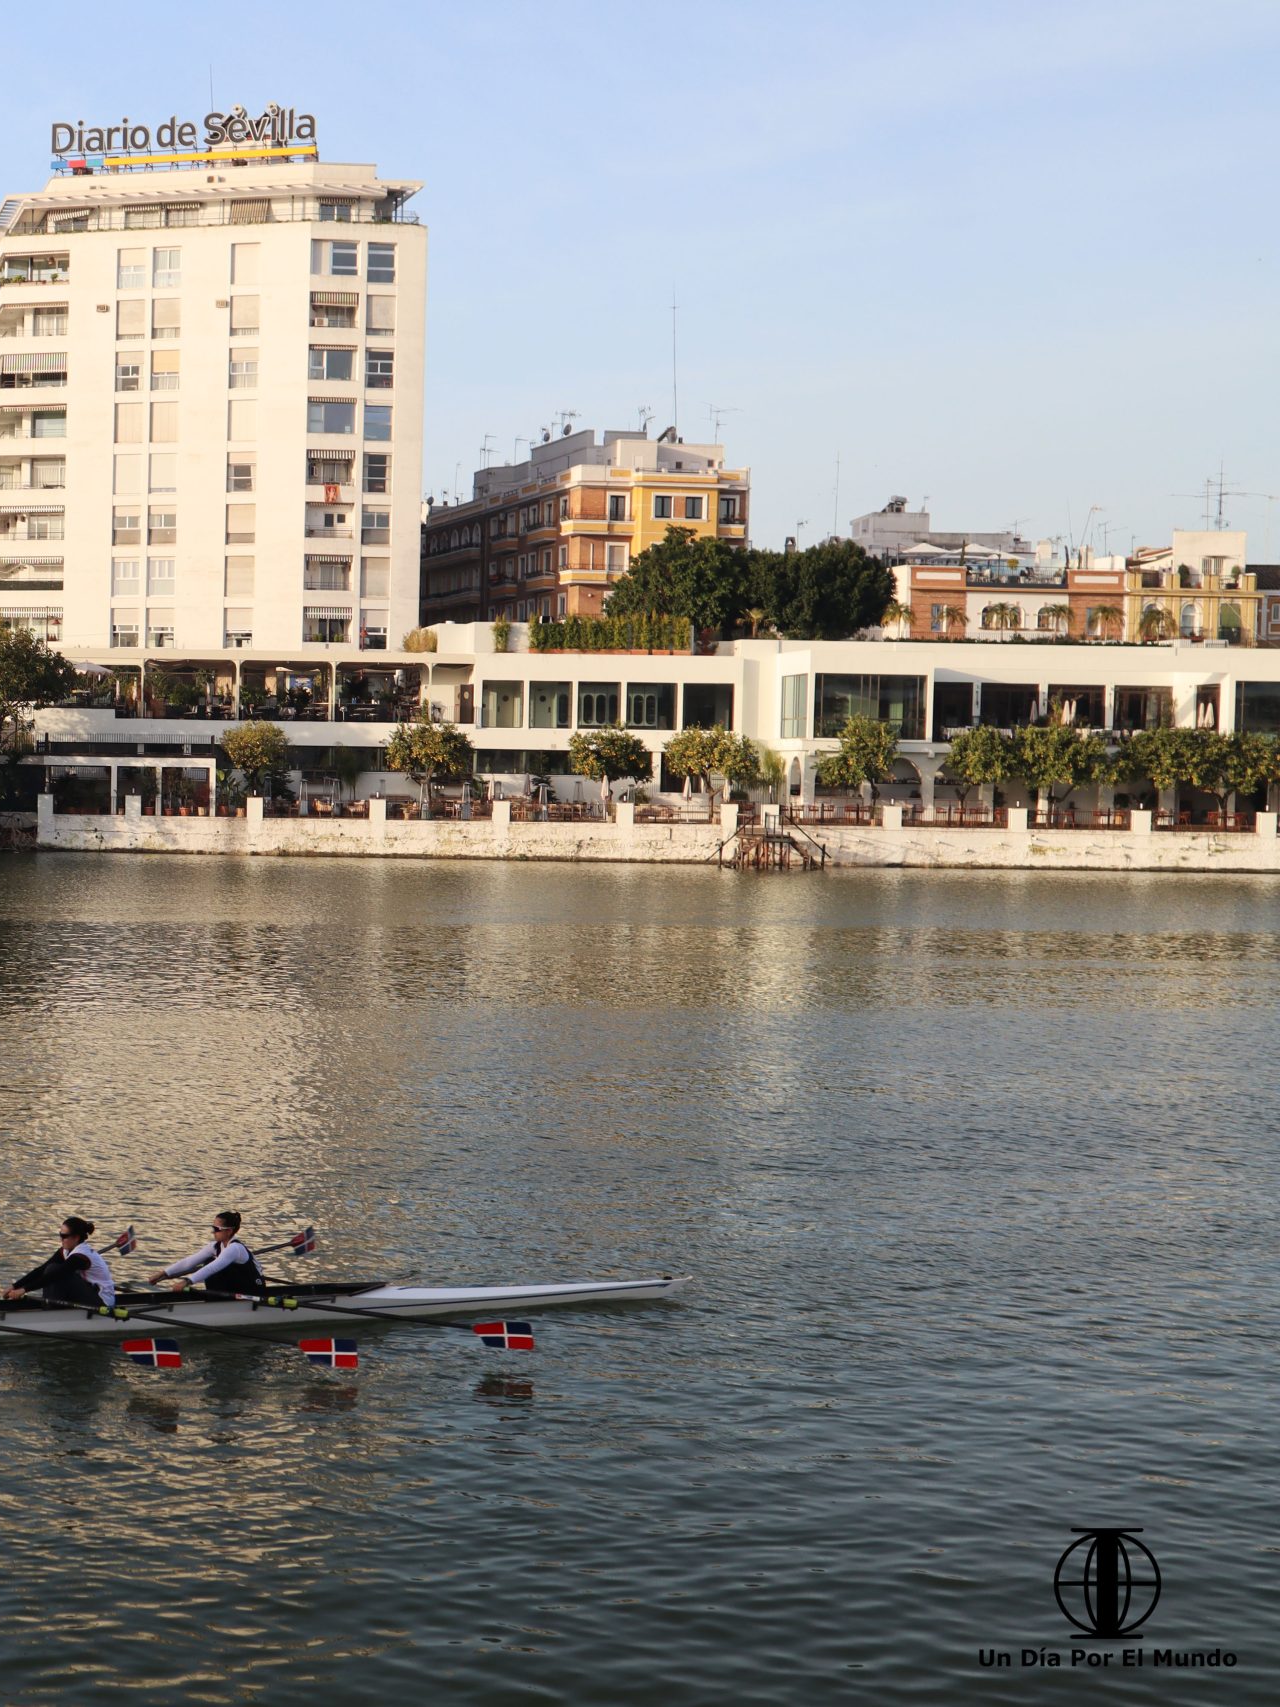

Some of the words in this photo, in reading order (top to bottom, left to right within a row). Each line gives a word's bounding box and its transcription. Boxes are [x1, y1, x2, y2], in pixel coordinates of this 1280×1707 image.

[51, 118, 150, 153] Diario
[156, 116, 197, 148] de
[203, 106, 316, 145] Sevilla
